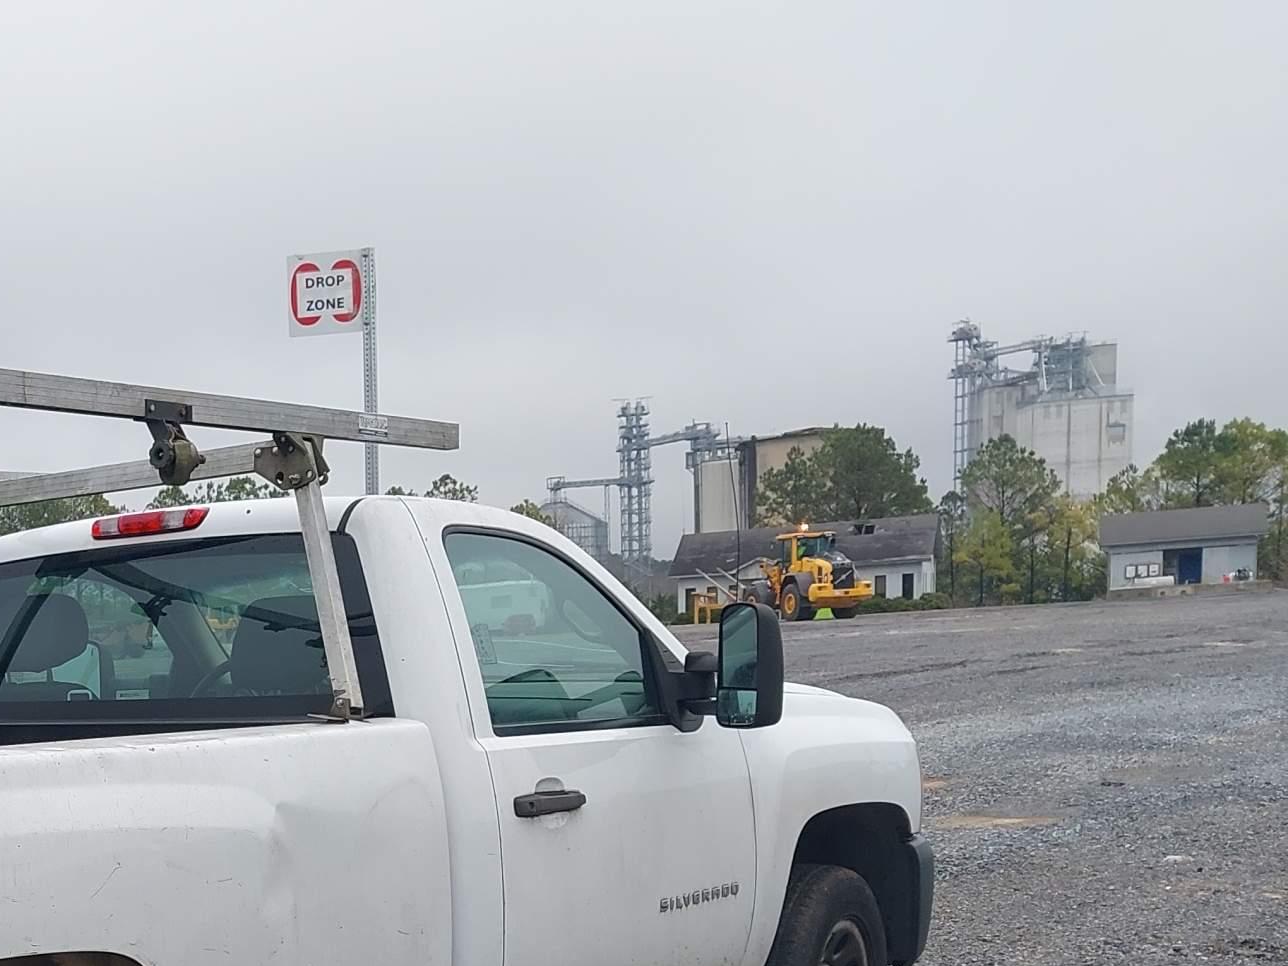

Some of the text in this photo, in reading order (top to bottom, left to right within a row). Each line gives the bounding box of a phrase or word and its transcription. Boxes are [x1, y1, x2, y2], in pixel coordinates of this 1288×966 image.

[305, 275, 345, 289] DROP
[306, 297, 345, 312] ZONE
[659, 881, 740, 913] SILVERADO
